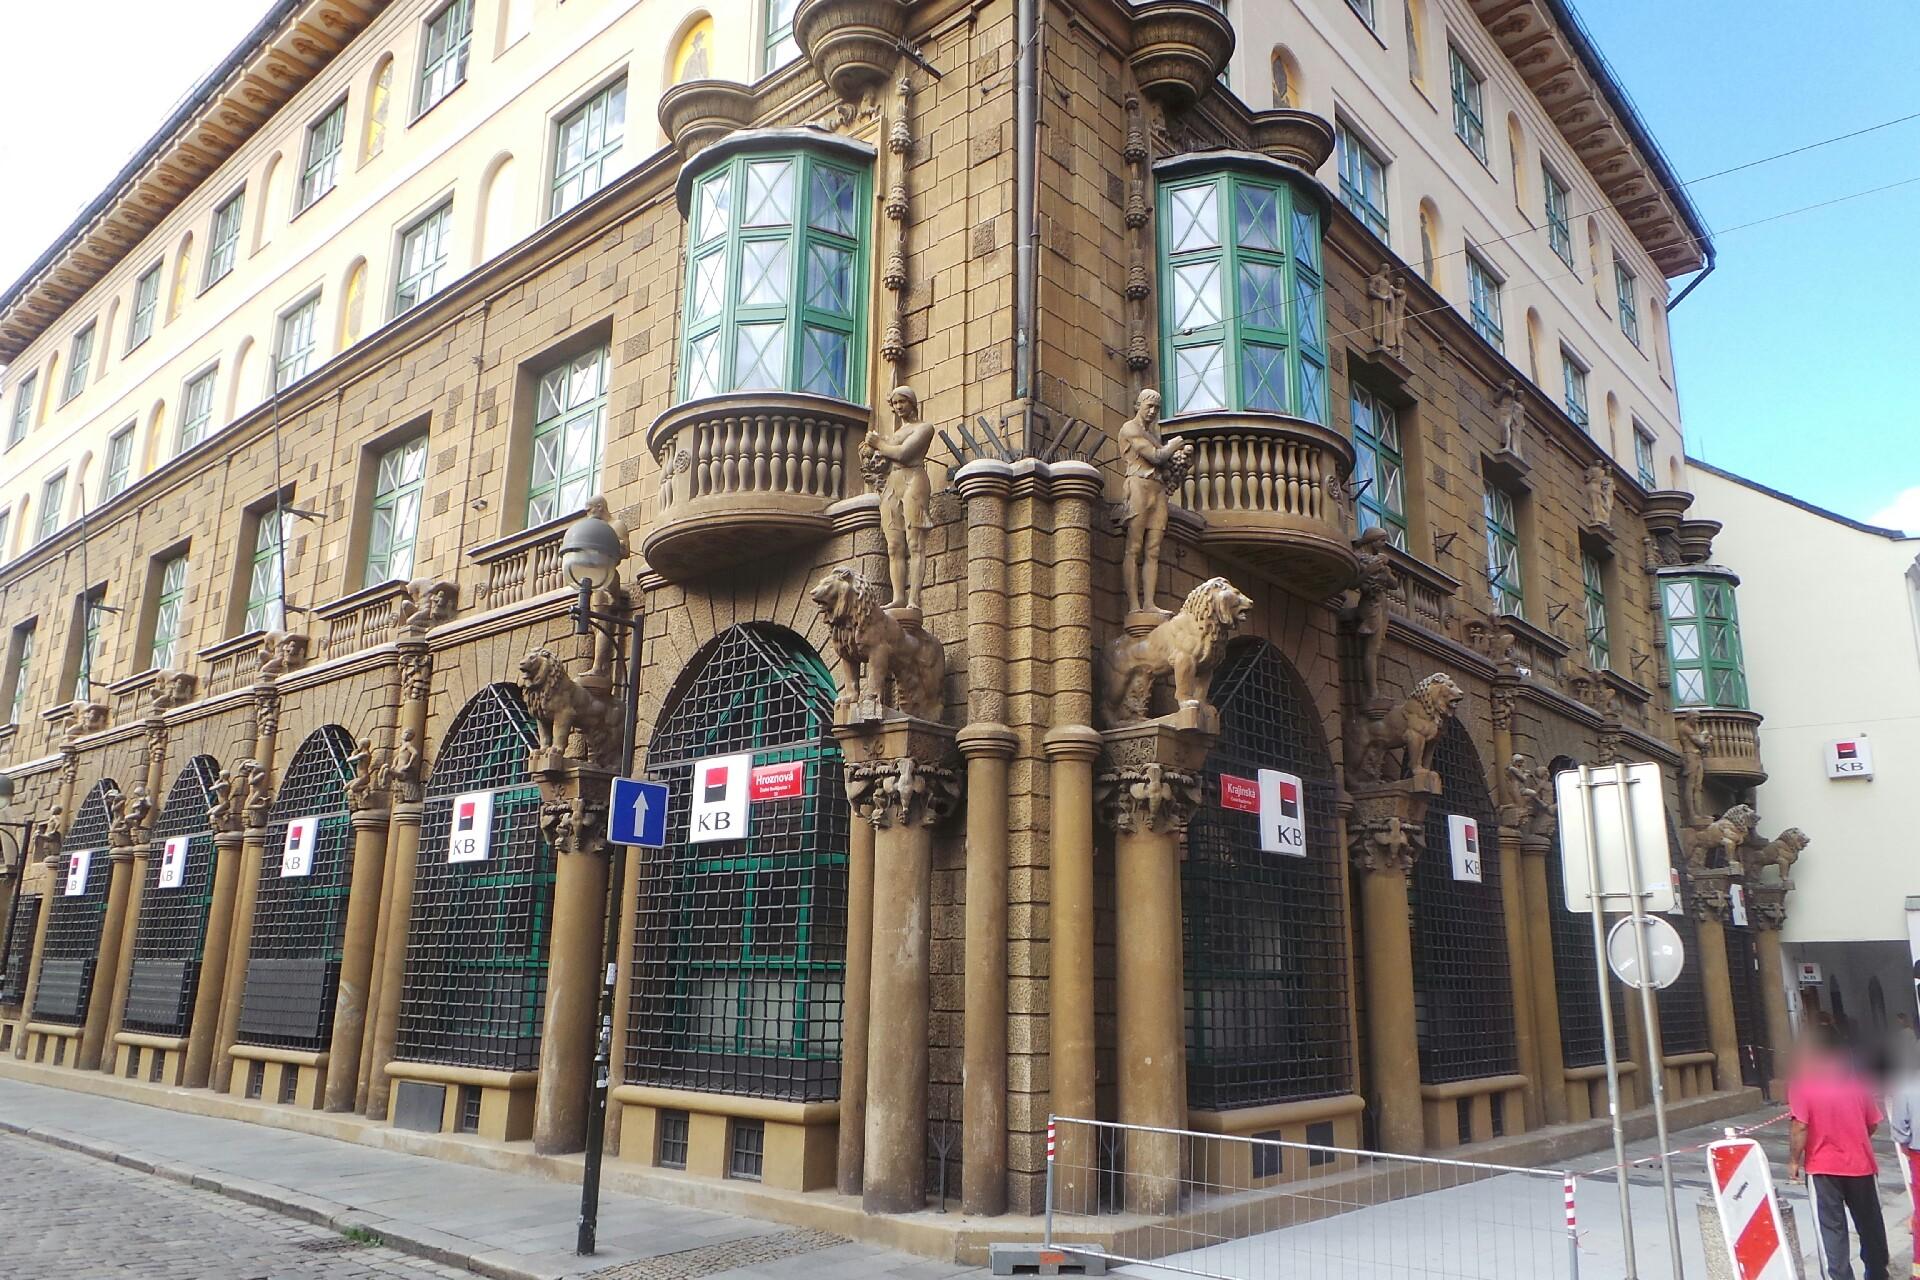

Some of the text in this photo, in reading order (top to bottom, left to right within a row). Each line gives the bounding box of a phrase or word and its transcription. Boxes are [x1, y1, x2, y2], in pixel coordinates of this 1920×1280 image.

[1835, 762, 1864, 772] KB
[755, 770, 794, 785] Hroznová
[697, 811, 731, 832] KB
[1277, 824, 1303, 847] KB
[453, 838, 476, 855] KB
